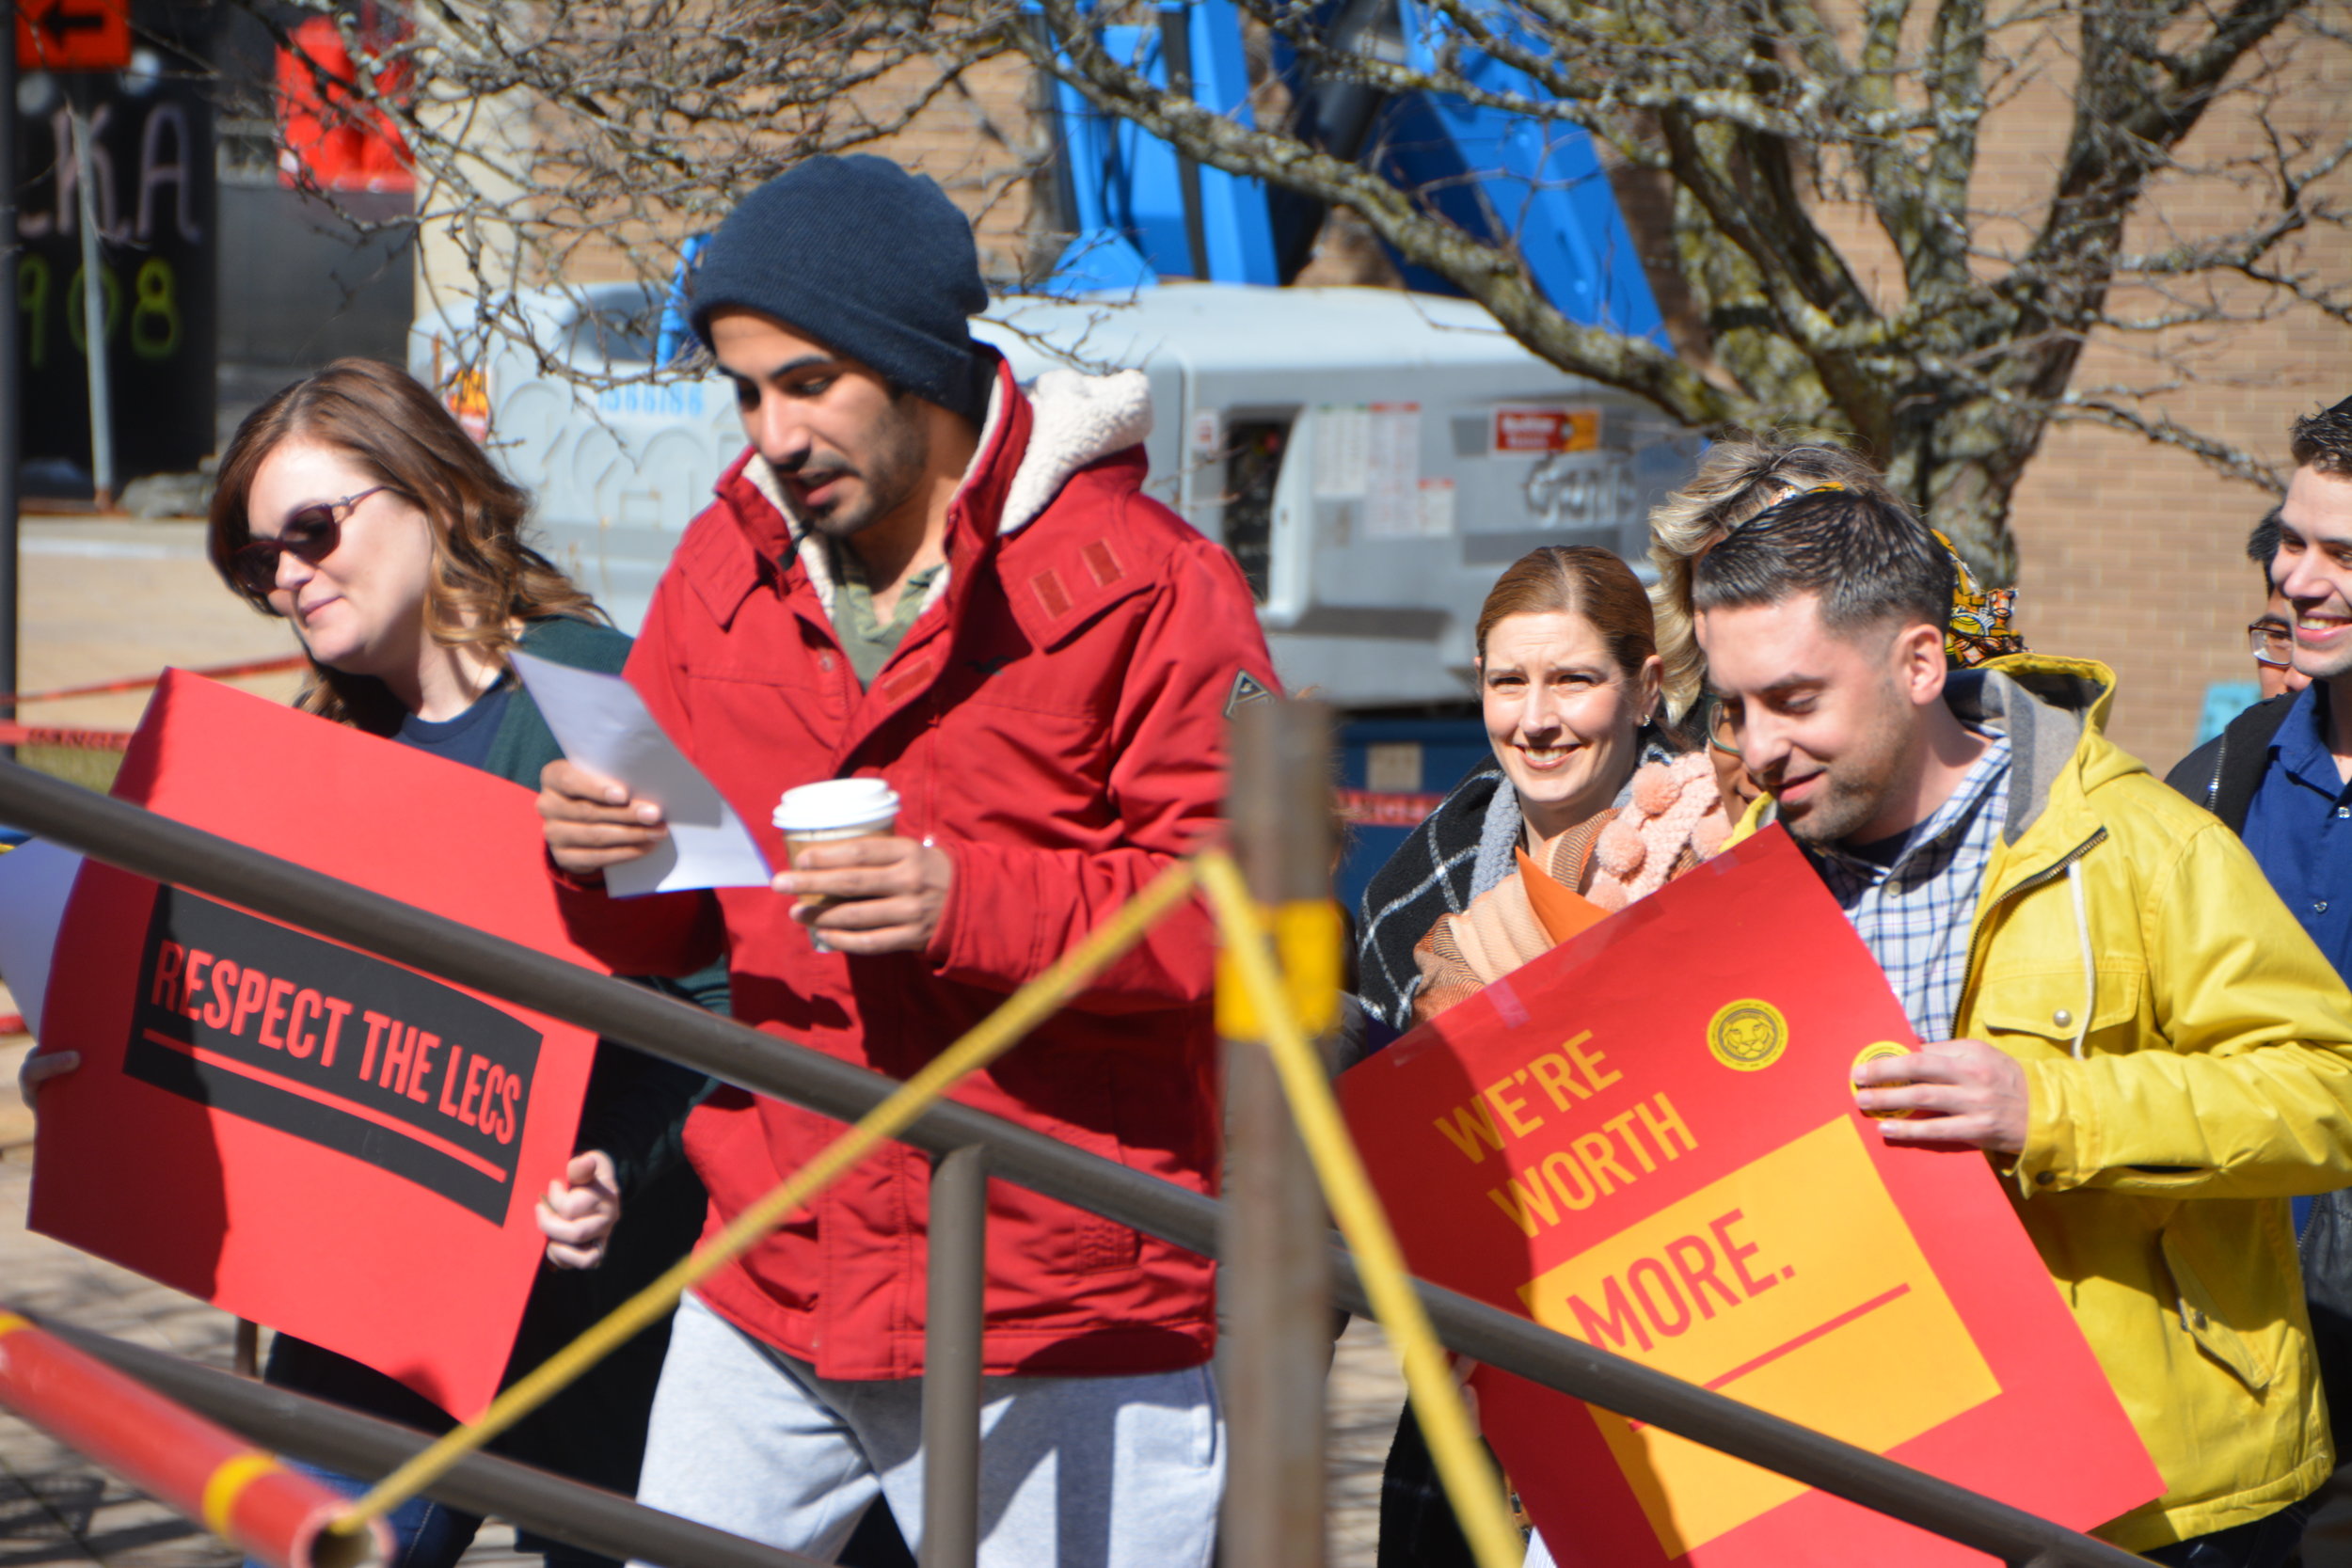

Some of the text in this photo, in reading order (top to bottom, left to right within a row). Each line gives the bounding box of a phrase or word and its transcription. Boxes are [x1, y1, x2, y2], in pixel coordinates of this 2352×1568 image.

[18, 103, 201, 245] KA
[27, 728, 133, 752] DANGE
[151, 939, 522, 1145] RESPECT THE LECS
[1433, 1029, 1624, 1164] WE'RE
[1486, 1091, 1699, 1239] WORTH
[1565, 1207, 1796, 1353] MORE.
